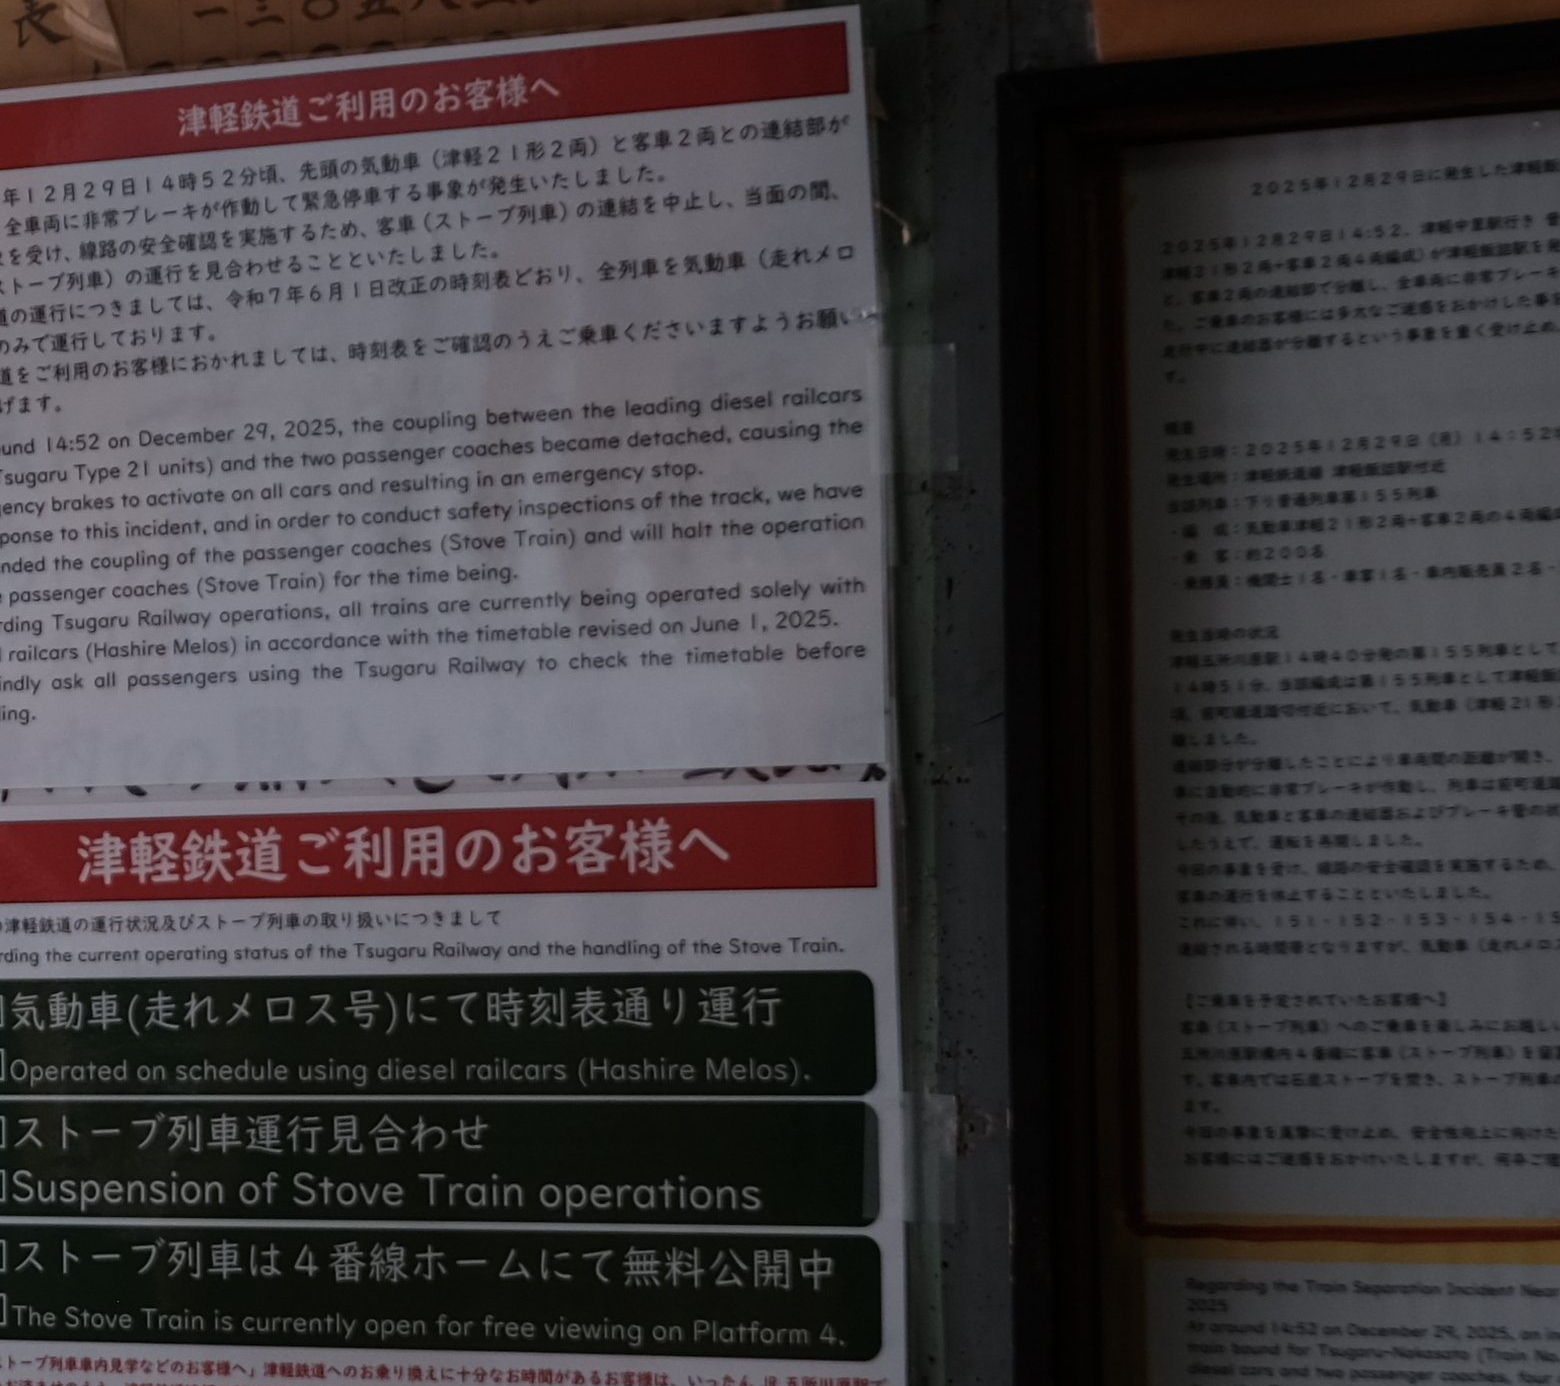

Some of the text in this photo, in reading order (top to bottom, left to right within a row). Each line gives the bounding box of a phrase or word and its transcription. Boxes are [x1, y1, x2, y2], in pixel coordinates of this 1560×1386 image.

[177, 76, 560, 139] 津軽鉄道ご利用のお客様へ
[9, 586, 106, 608] passenger
[112, 579, 189, 599] coaches
[197, 576, 259, 599] (Stove
[266, 572, 325, 594] Train)
[334, 570, 361, 588] for
[368, 569, 401, 586] the
[407, 566, 449, 584] time
[457, 563, 518, 585] being.
[77, 818, 729, 887] 津軽鉄道ご利用のお客様へ
[12, 986, 781, 1033] 気動車(走れメロス号)にて時刻表通り運行
[10, 1057, 810, 1088] Operated on schedule using diesel railcars (Hashire Melos).
[12, 1110, 488, 1155] ストーブ列車運行見合わせ
[12, 1169, 762, 1218] Suspension of Stove Train operations
[12, 1235, 836, 1293] ストーブ列車は4番線ホームにて無料公開中
